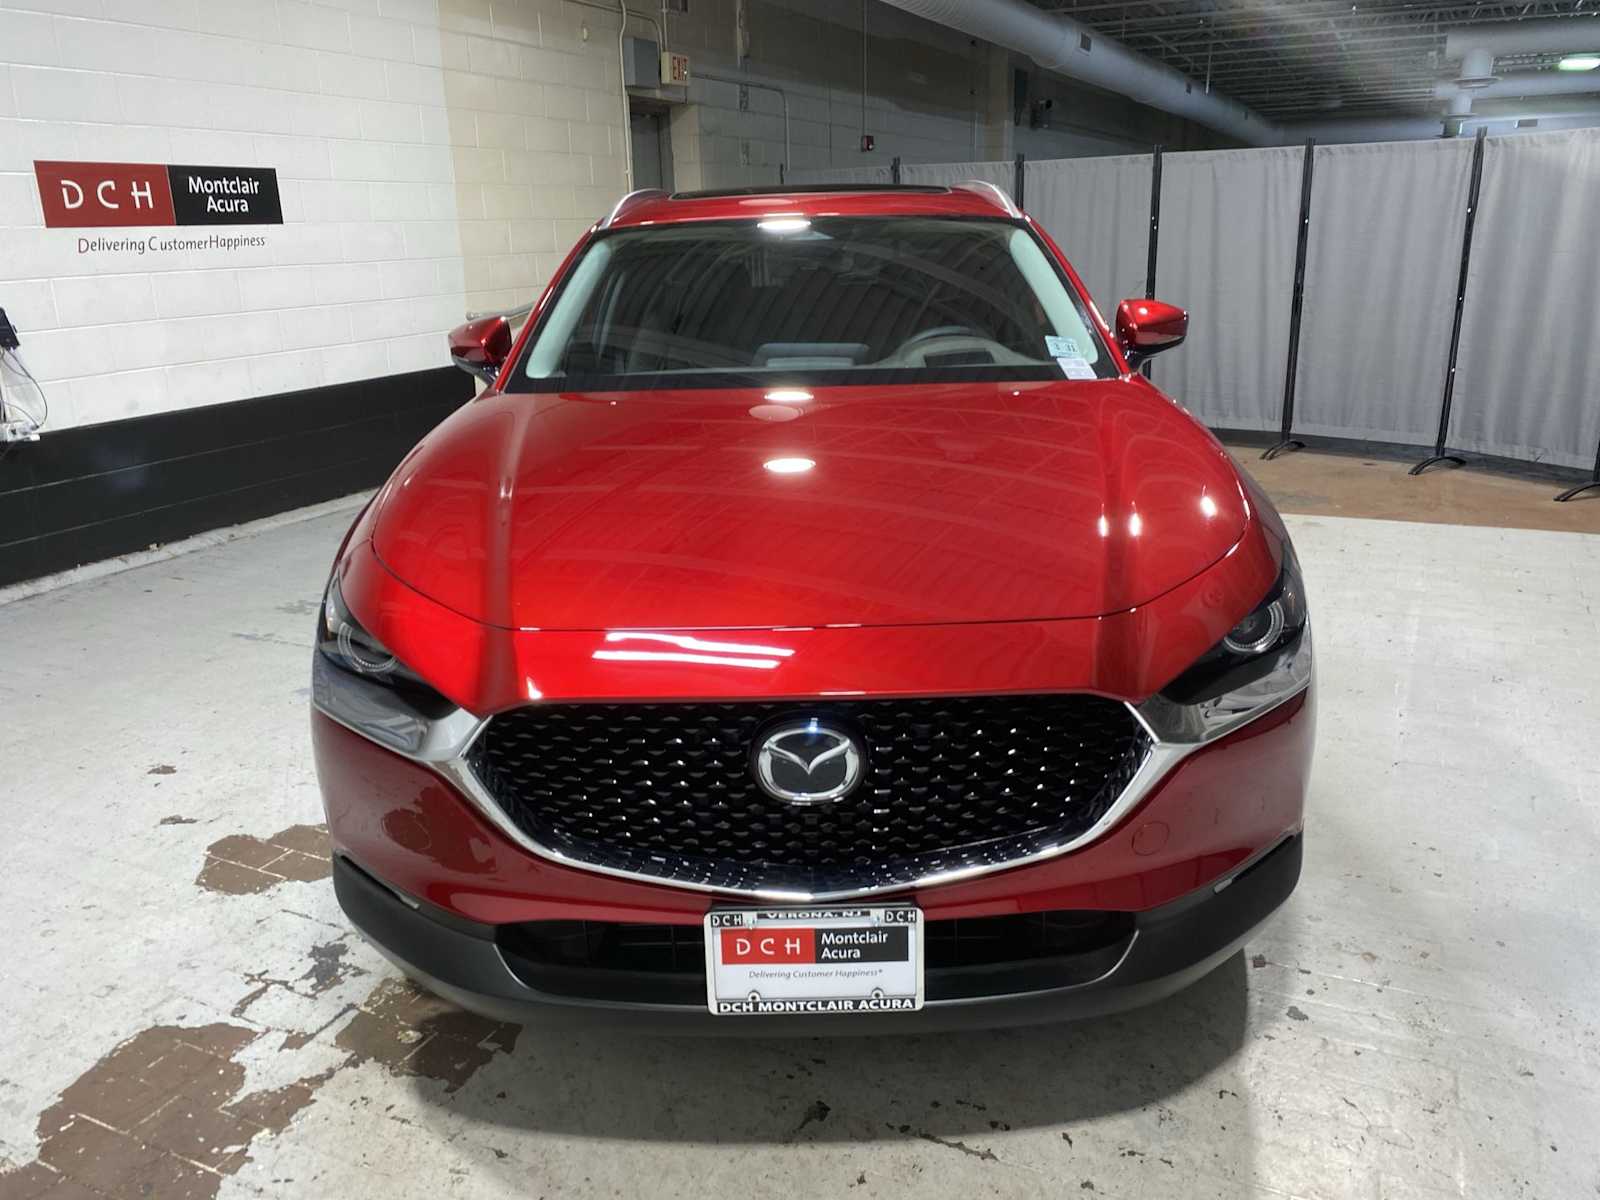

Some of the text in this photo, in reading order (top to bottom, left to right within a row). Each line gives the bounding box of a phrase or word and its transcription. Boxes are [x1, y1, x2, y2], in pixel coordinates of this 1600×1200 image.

[188, 176, 261, 196] Montclair
[61, 179, 154, 210] DCH
[206, 196, 249, 213] Acura
[78, 234, 266, 255] Delivering Customer Happiness
[711, 915, 743, 927] DCH
[884, 911, 916, 923] DCH
[821, 932, 888, 945] Montclair
[735, 938, 801, 955] DCH
[821, 947, 861, 960] Acura
[748, 970, 791, 979] Delivering
[793, 969, 834, 978] Customer
[719, 998, 914, 1013] DCH MONTCLAIR ACURA
